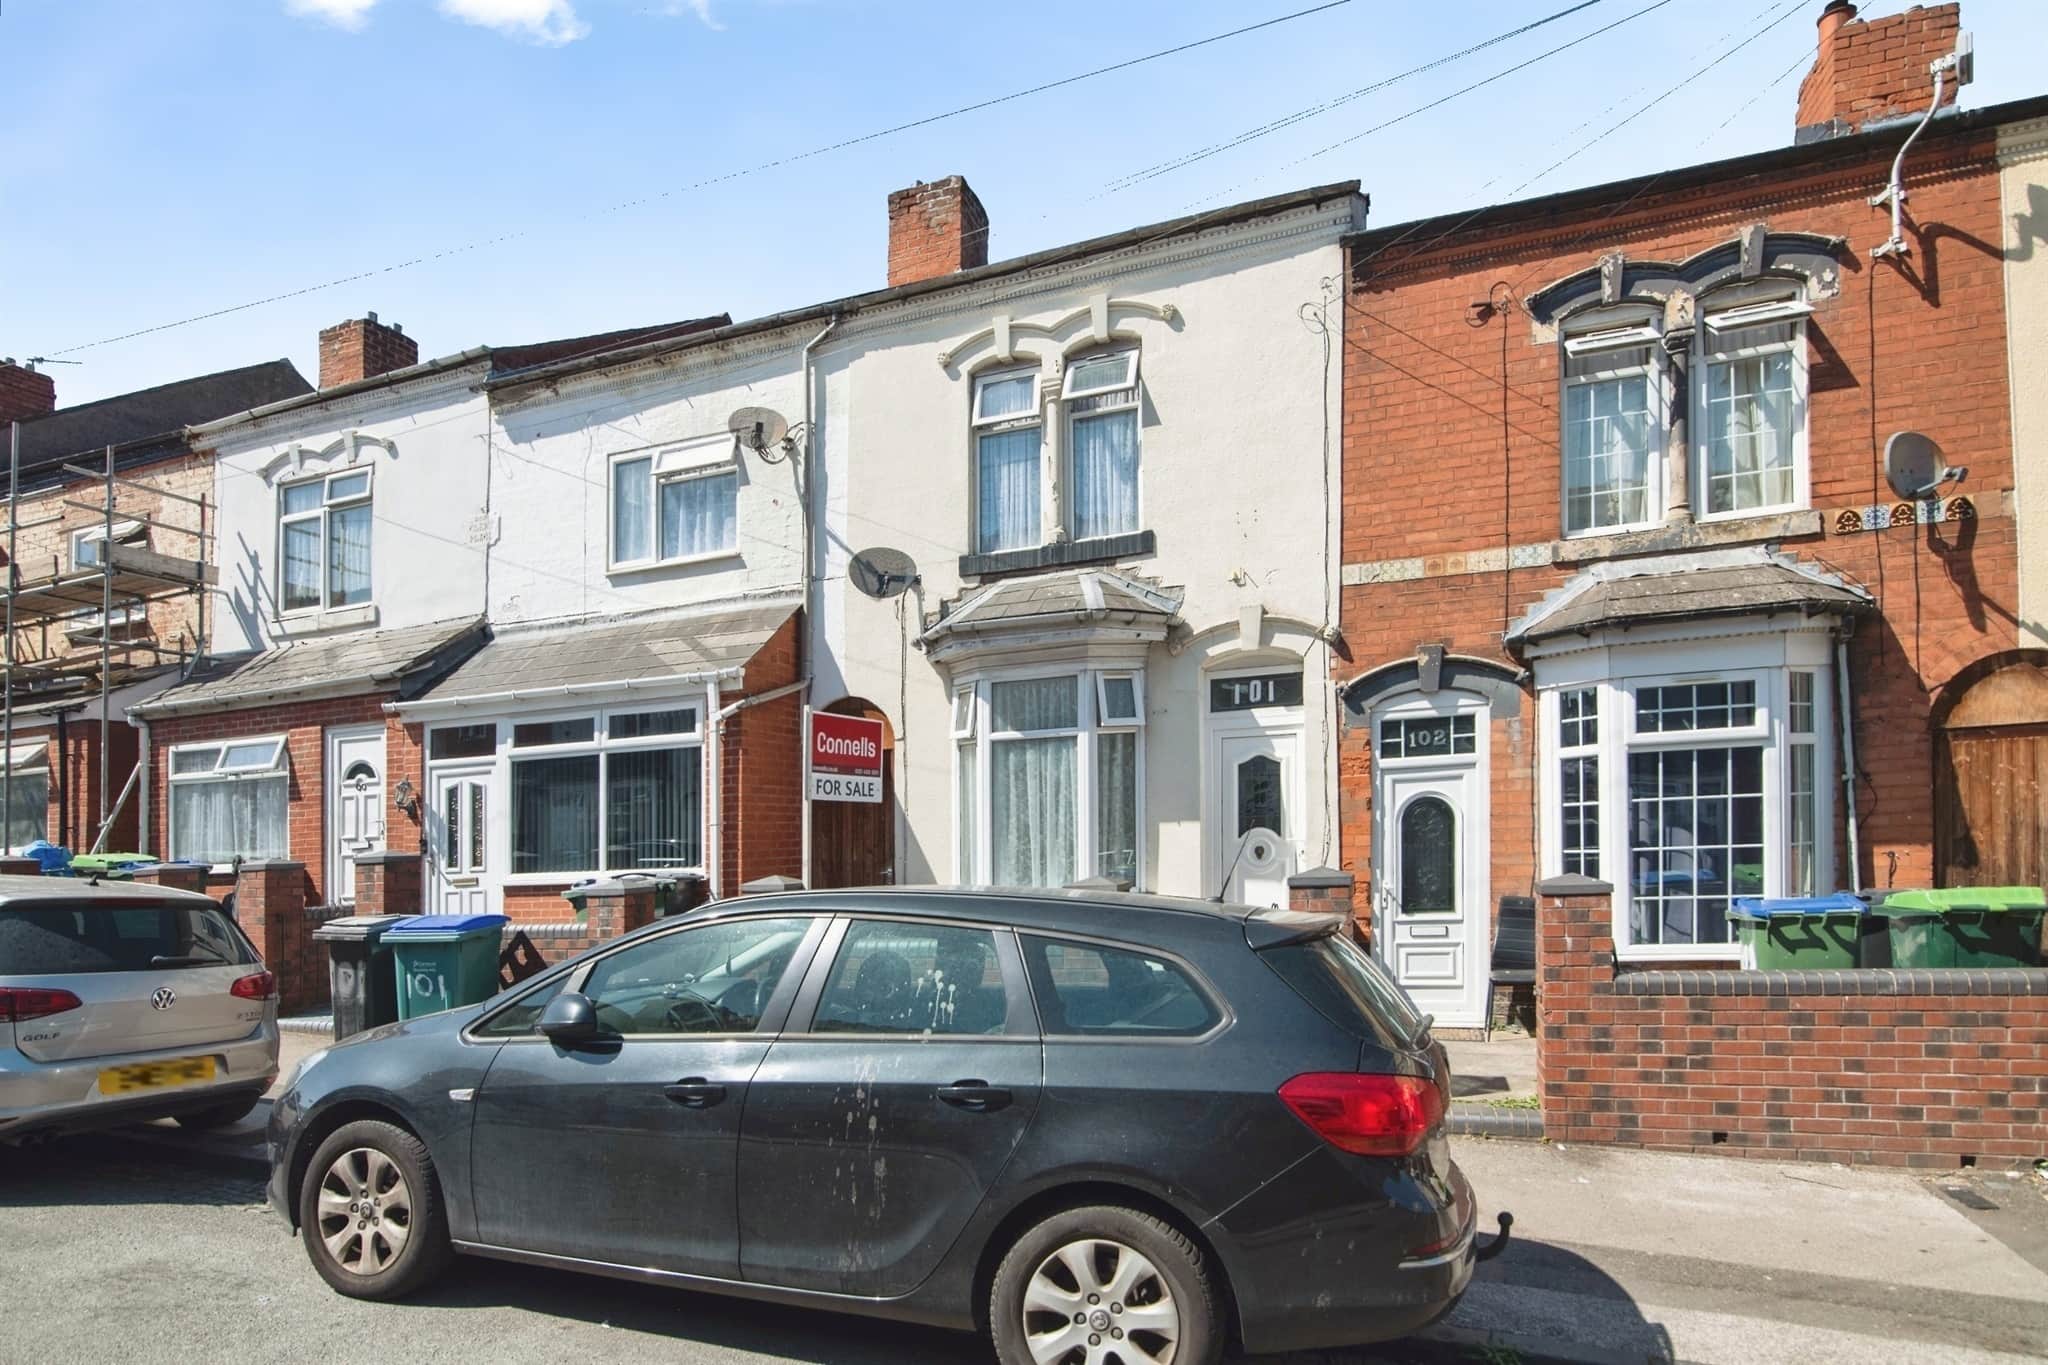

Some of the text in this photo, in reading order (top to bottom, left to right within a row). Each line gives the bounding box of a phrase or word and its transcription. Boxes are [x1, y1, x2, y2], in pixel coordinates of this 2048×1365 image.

[1233, 679, 1275, 705] 101
[817, 731, 877, 758] Connells
[1408, 729, 1447, 748] 102
[816, 779, 875, 798] FOR SALE
[406, 973, 446, 1001] 101
[22, 1031, 61, 1042] GOLF
